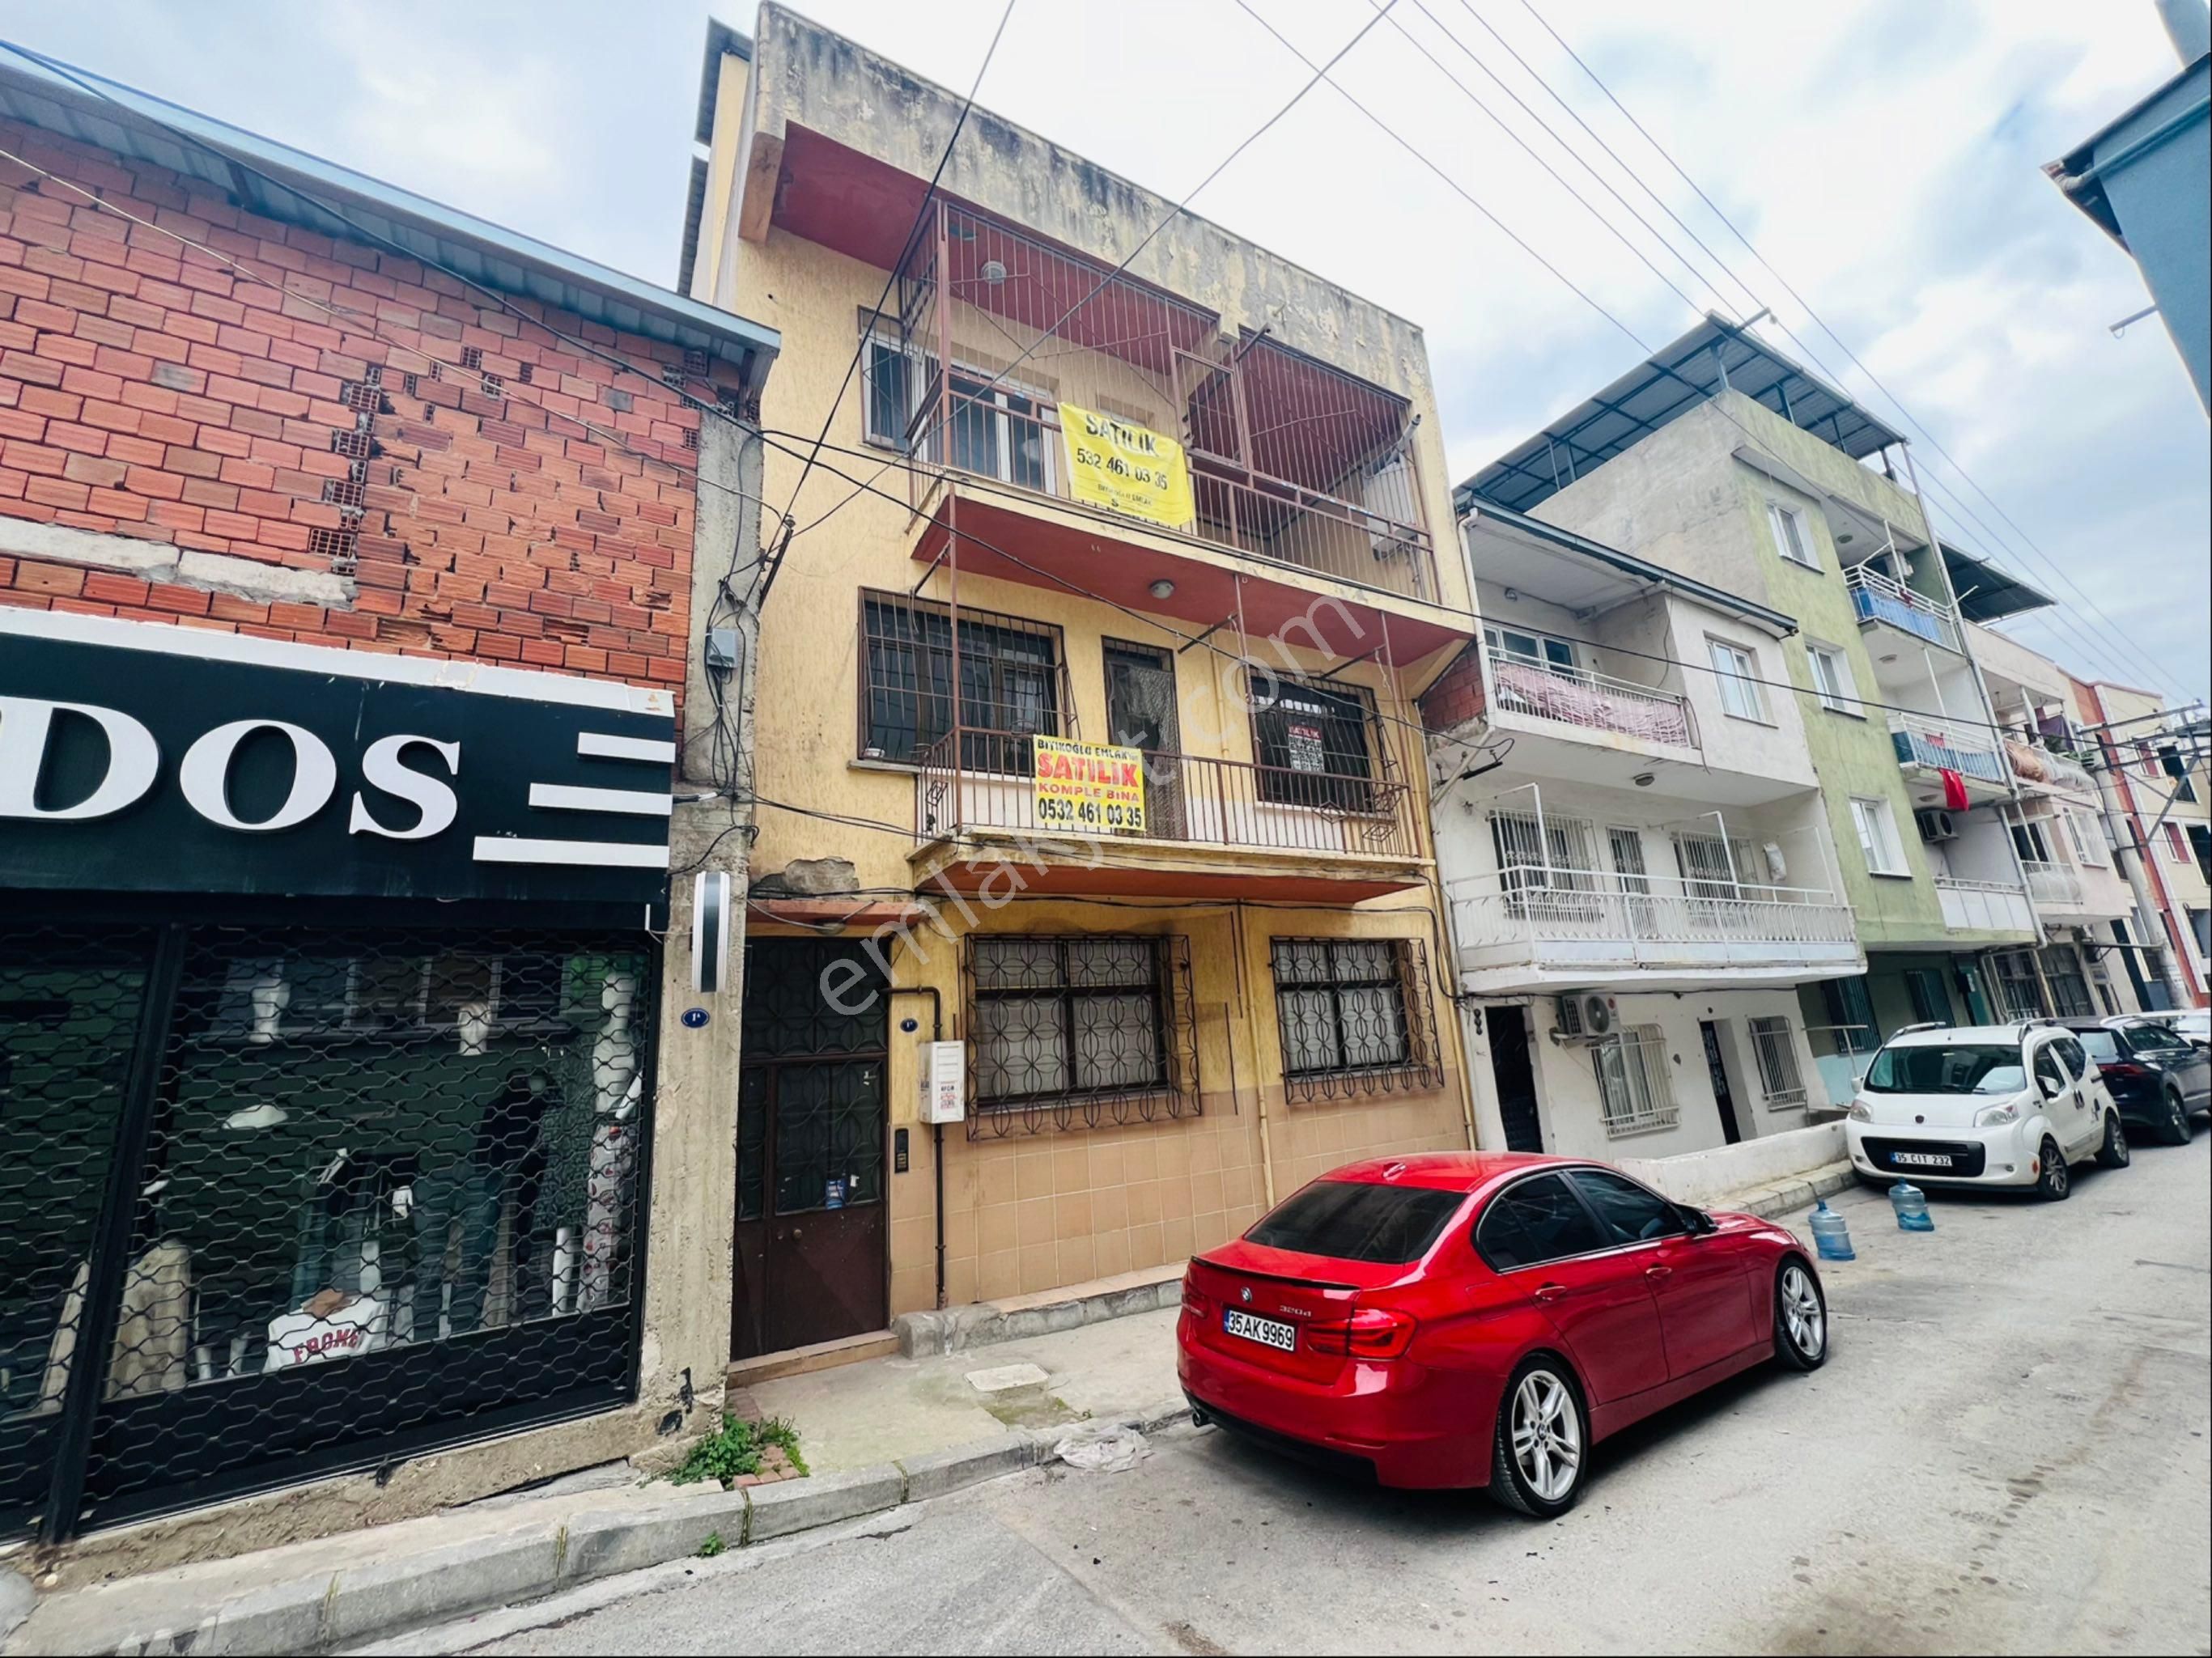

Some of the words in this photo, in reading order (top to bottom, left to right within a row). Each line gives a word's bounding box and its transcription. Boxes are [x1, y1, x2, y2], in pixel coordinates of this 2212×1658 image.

[1086, 413, 1159, 457] SATILIK
[1076, 447, 1102, 469] 532
[1106, 456, 1130, 478] 461
[1135, 465, 1151, 483] 03
[1155, 471, 1168, 490] 35
[0, 695, 461, 840] DOS
[1038, 782, 1102, 798] KOMPLE
[1038, 798, 1074, 821] 0532
[1078, 802, 1102, 823] 461
[1106, 804, 1123, 825] 03
[1127, 808, 1142, 827] 35
[1897, 1153, 1907, 1163] 35
[1932, 1156, 1950, 1165] 232
[1229, 1312, 1243, 1334] 35
[1243, 1317, 1261, 1339] AK
[1263, 1322, 1294, 1348] 9969
